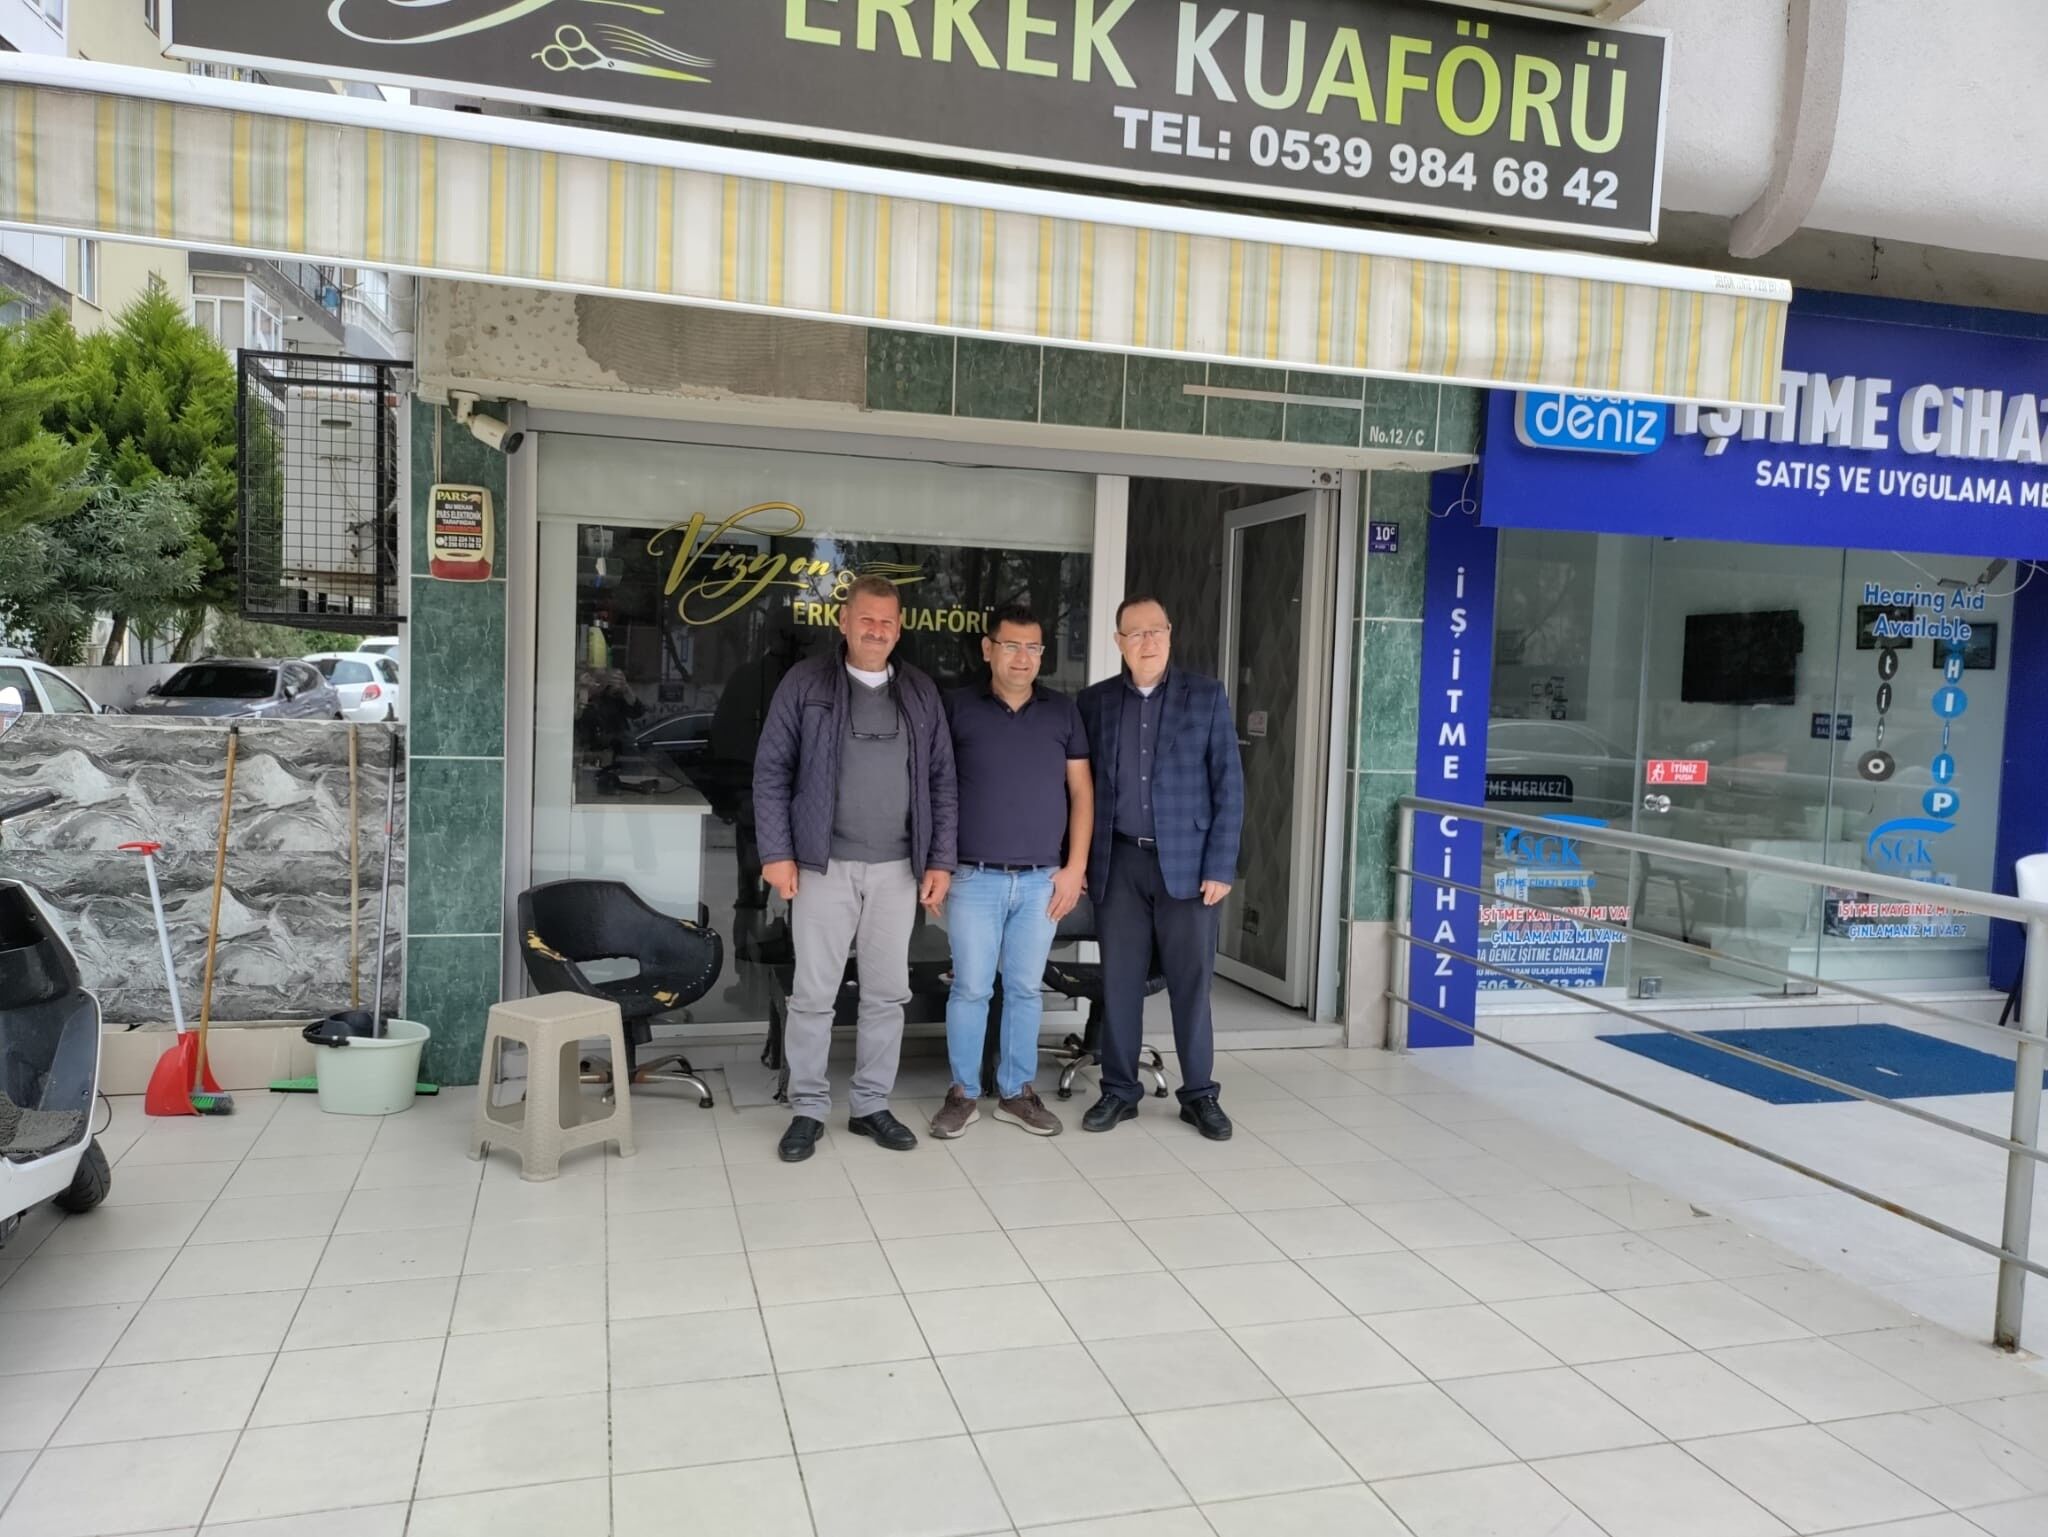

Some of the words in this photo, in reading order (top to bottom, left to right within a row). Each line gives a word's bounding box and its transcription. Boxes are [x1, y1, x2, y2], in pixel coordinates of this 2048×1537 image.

[1175, 1, 1627, 153] KUAFÖRÜ
[1113, 105, 1231, 161] TEL:
[1249, 125, 1373, 177] 0539
[1389, 143, 1477, 192] 984
[1493, 157, 1548, 200] 68
[1563, 167, 1619, 209] 42
[1535, 392, 1658, 446] deniz
[1369, 426, 1403, 445] No.12
[1415, 430, 1425, 446] C
[437, 491, 469, 501] PARS
[1756, 460, 1831, 497] SATIŞ
[1839, 465, 1870, 494] VE
[1878, 469, 2013, 506] UYGULAMA
[647, 502, 833, 625] Vizyon
[1863, 582, 1946, 613] Hearing
[1950, 587, 1986, 610] Aid
[793, 602, 841, 628] ERK
[900, 603, 996, 634] UAFÖRÜ
[1872, 613, 1972, 641] Available
[1438, 566, 1467, 780] İŞİTME
[1511, 778, 1567, 797] MERKEZİ
[1518, 835, 1582, 866] SGK
[1878, 838, 1934, 865] SGK
[1433, 815, 1459, 1008] CİHAZI
[1838, 899, 1878, 920] İŞİTME
[1880, 903, 1934, 918] KAYBINIZ
[1491, 929, 1575, 948] ÇINLAMANIZ
[1849, 923, 1920, 942] ÇINLAMANIZ
[1921, 925, 1936, 938] MI
[1552, 943, 1604, 962] CİHAZLARI
